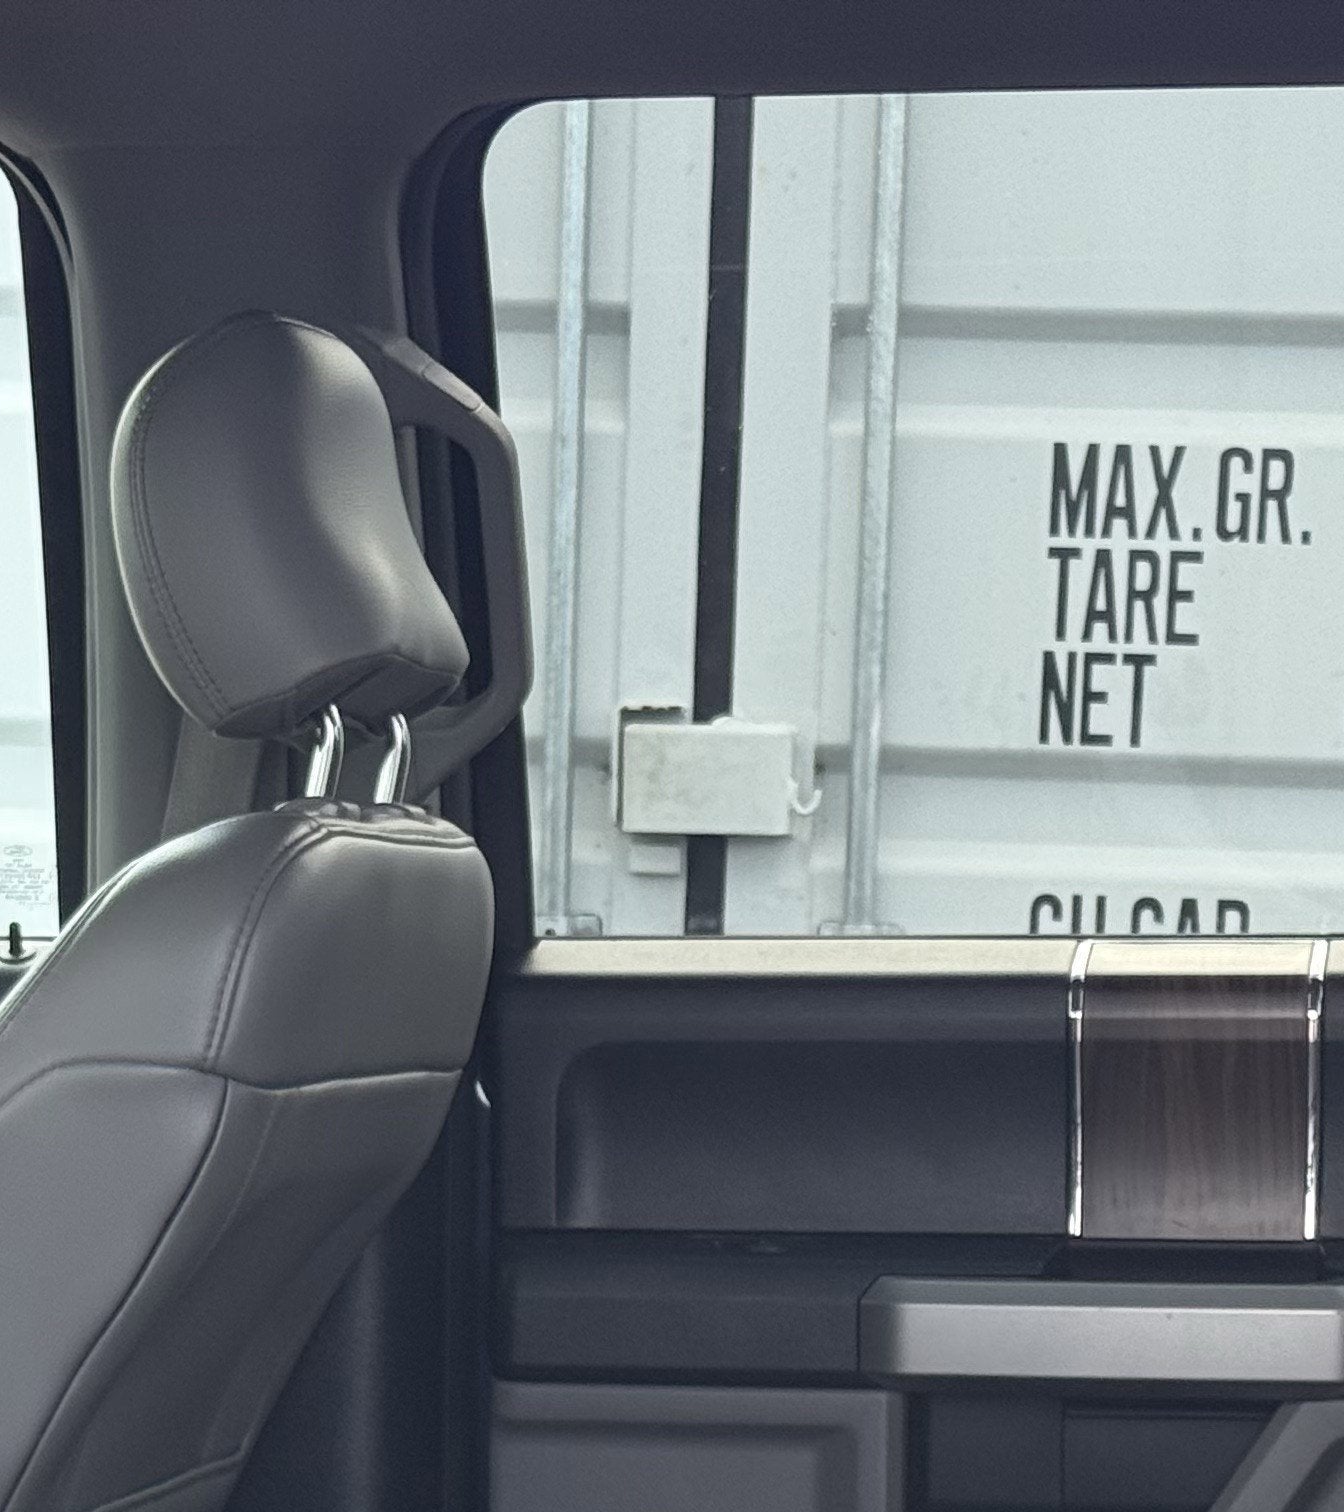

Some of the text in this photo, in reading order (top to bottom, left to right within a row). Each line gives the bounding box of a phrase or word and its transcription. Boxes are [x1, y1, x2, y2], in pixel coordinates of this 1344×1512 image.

[1047, 441, 1313, 546] MAX.GR.
[1046, 545, 1205, 647] TARE
[1037, 649, 1158, 749] NET
